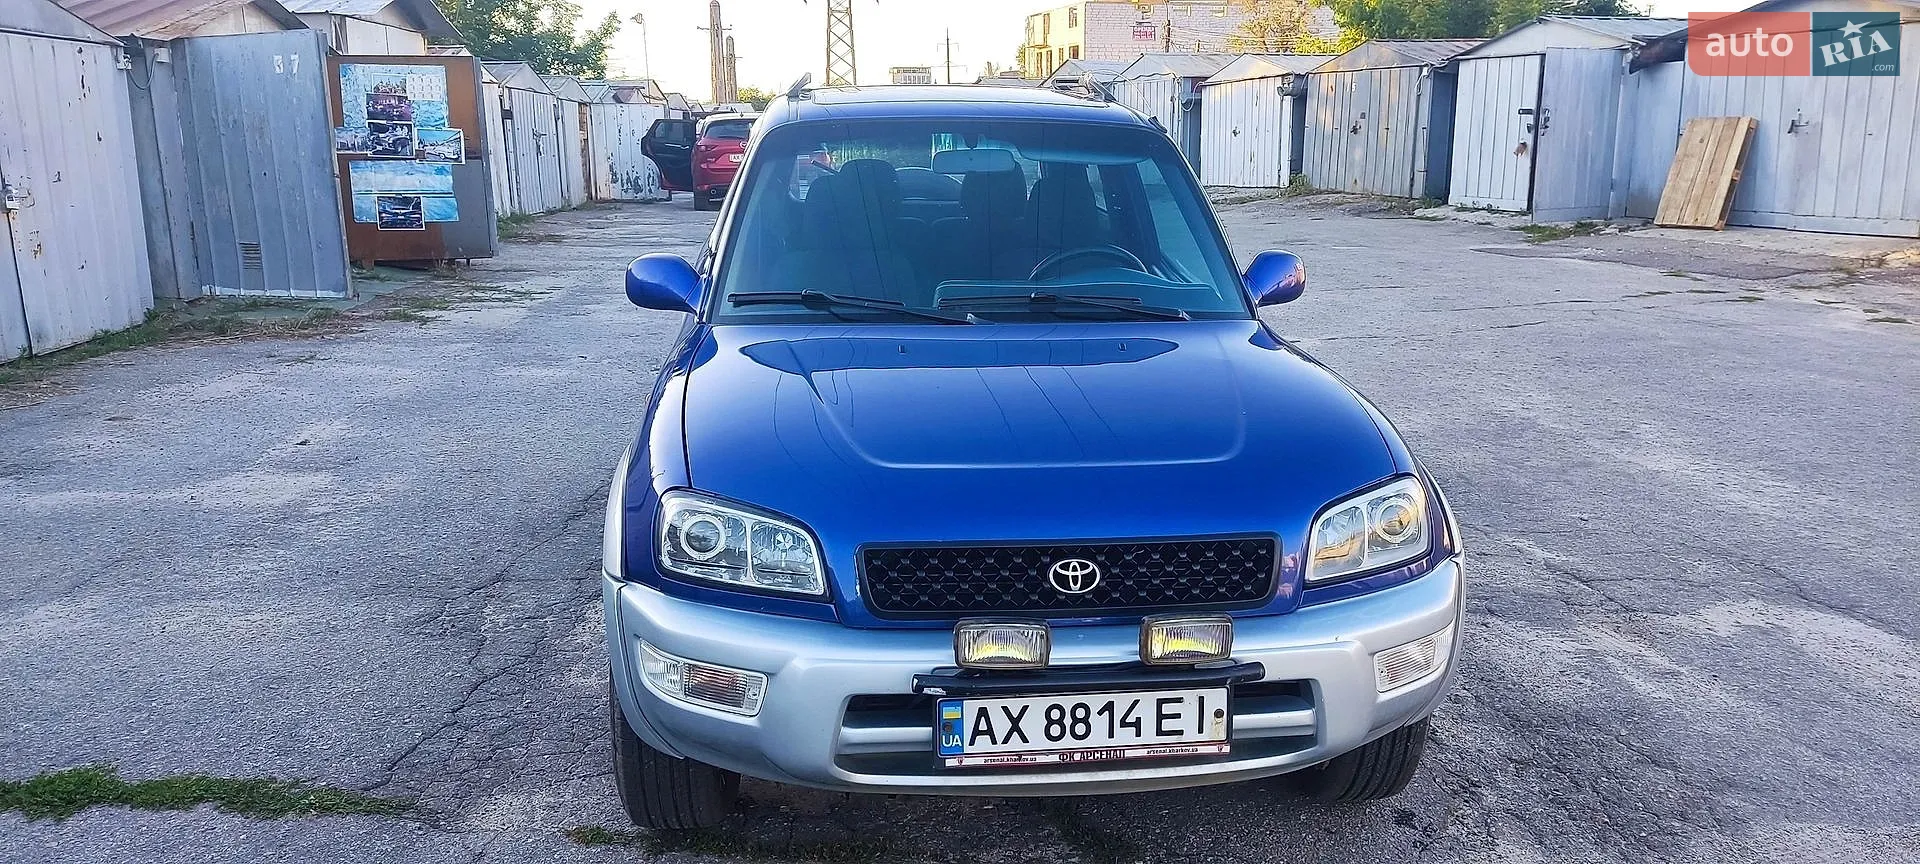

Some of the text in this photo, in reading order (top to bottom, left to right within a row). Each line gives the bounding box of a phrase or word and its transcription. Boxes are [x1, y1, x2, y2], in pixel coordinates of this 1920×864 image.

[968, 704, 1030, 747] AX
[1044, 699, 1141, 743] 8814
[942, 734, 962, 747] UA
[1058, 749, 1126, 762] ФК АРСЕНАЛ
[1146, 747, 1199, 755] arsenal.kharkov.ua
